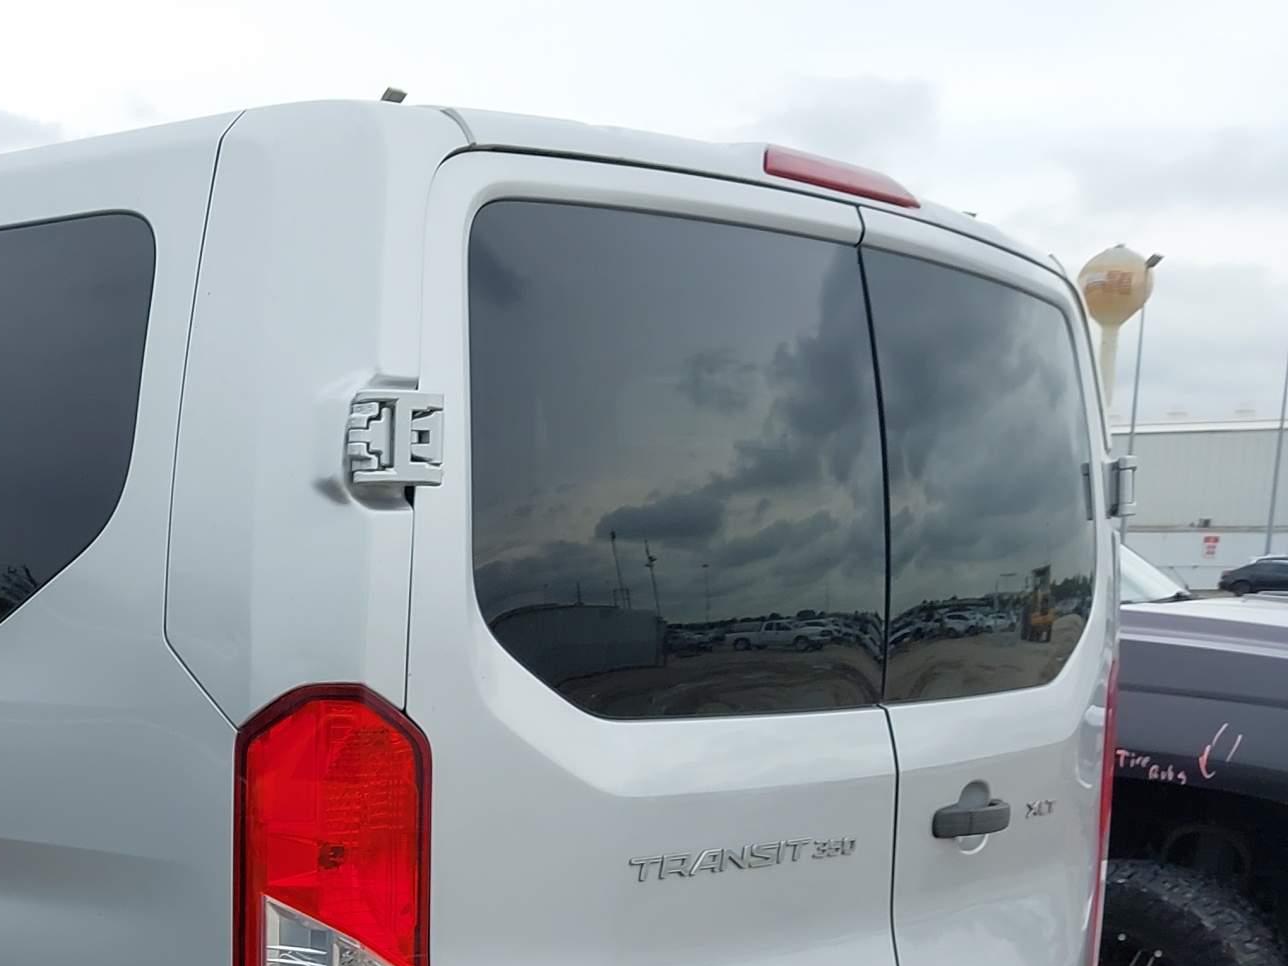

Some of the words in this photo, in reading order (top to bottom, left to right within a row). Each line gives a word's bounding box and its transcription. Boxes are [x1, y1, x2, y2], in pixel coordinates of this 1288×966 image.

[1025, 799, 1056, 819] XLT
[629, 838, 811, 882] TRANSIT
[812, 837, 856, 860] 350
